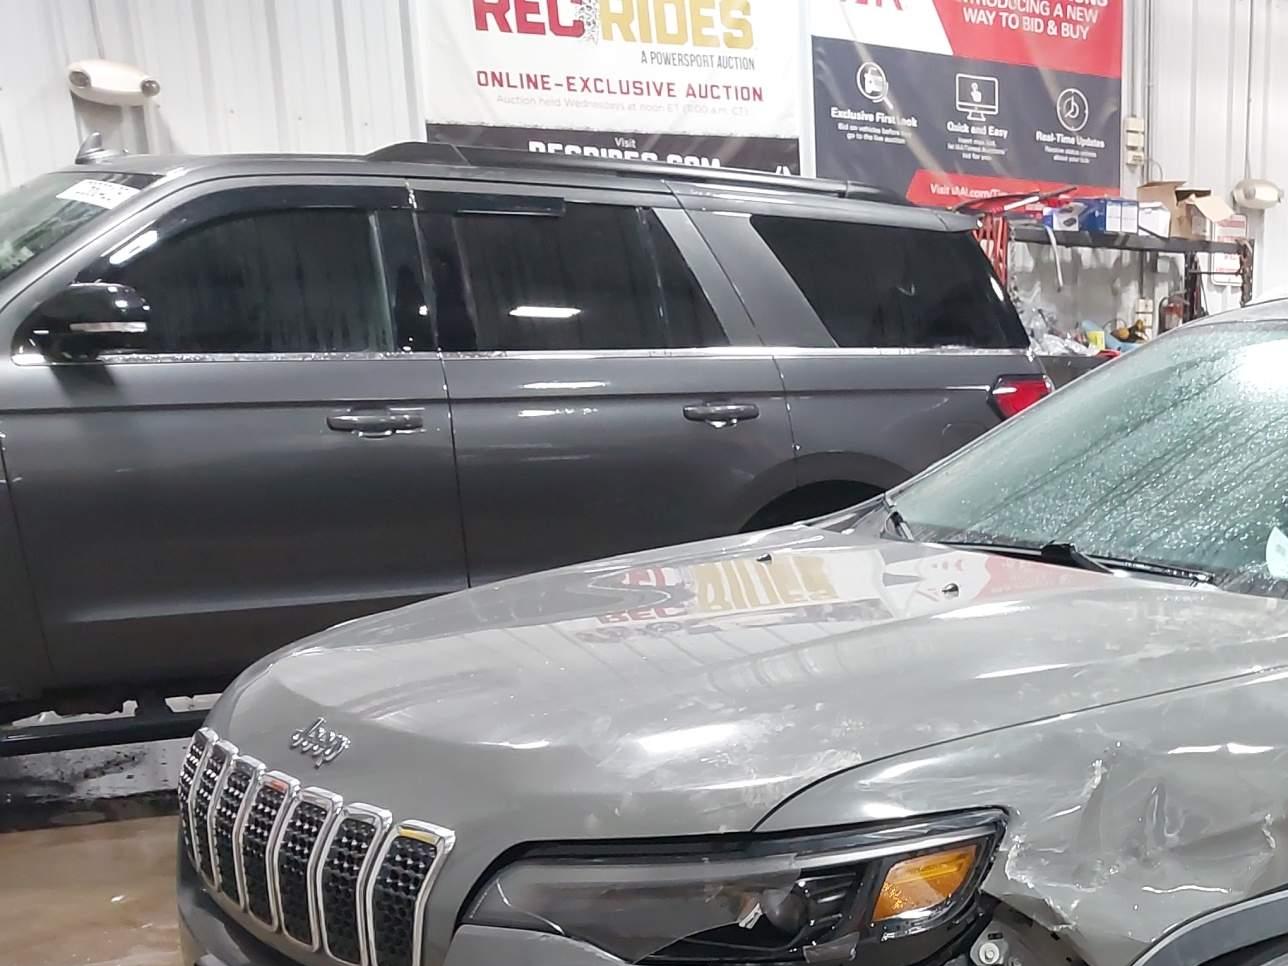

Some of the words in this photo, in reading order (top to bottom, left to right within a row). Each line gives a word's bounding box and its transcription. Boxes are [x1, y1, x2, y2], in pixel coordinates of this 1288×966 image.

[1053, 4, 1063, 18] A
[1066, 5, 1098, 23] NEW
[473, 0, 586, 38] REC
[600, 0, 754, 49] RIDES
[963, 7, 997, 26] WAY
[999, 12, 1020, 30] TO
[1022, 16, 1044, 33] BID
[1047, 20, 1057, 36] &
[1061, 22, 1090, 40] BUY
[640, 51, 648, 65] A
[650, 51, 715, 68] POWERSPORT
[717, 54, 756, 71] AUCTION
[476, 70, 677, 98] ONLINE-EXCLUSIVE
[686, 83, 764, 102] AUCTION
[831, 107, 874, 122] Exclusive
[875, 112, 896, 125] First
[946, 121, 969, 134] Quick
[971, 125, 987, 135] and
[988, 126, 1008, 139] Easy
[615, 137, 637, 149] Visit
[1035, 131, 1075, 144] Real-Time
[1076, 135, 1105, 148] Updates
[930, 183, 950, 195] Visit
